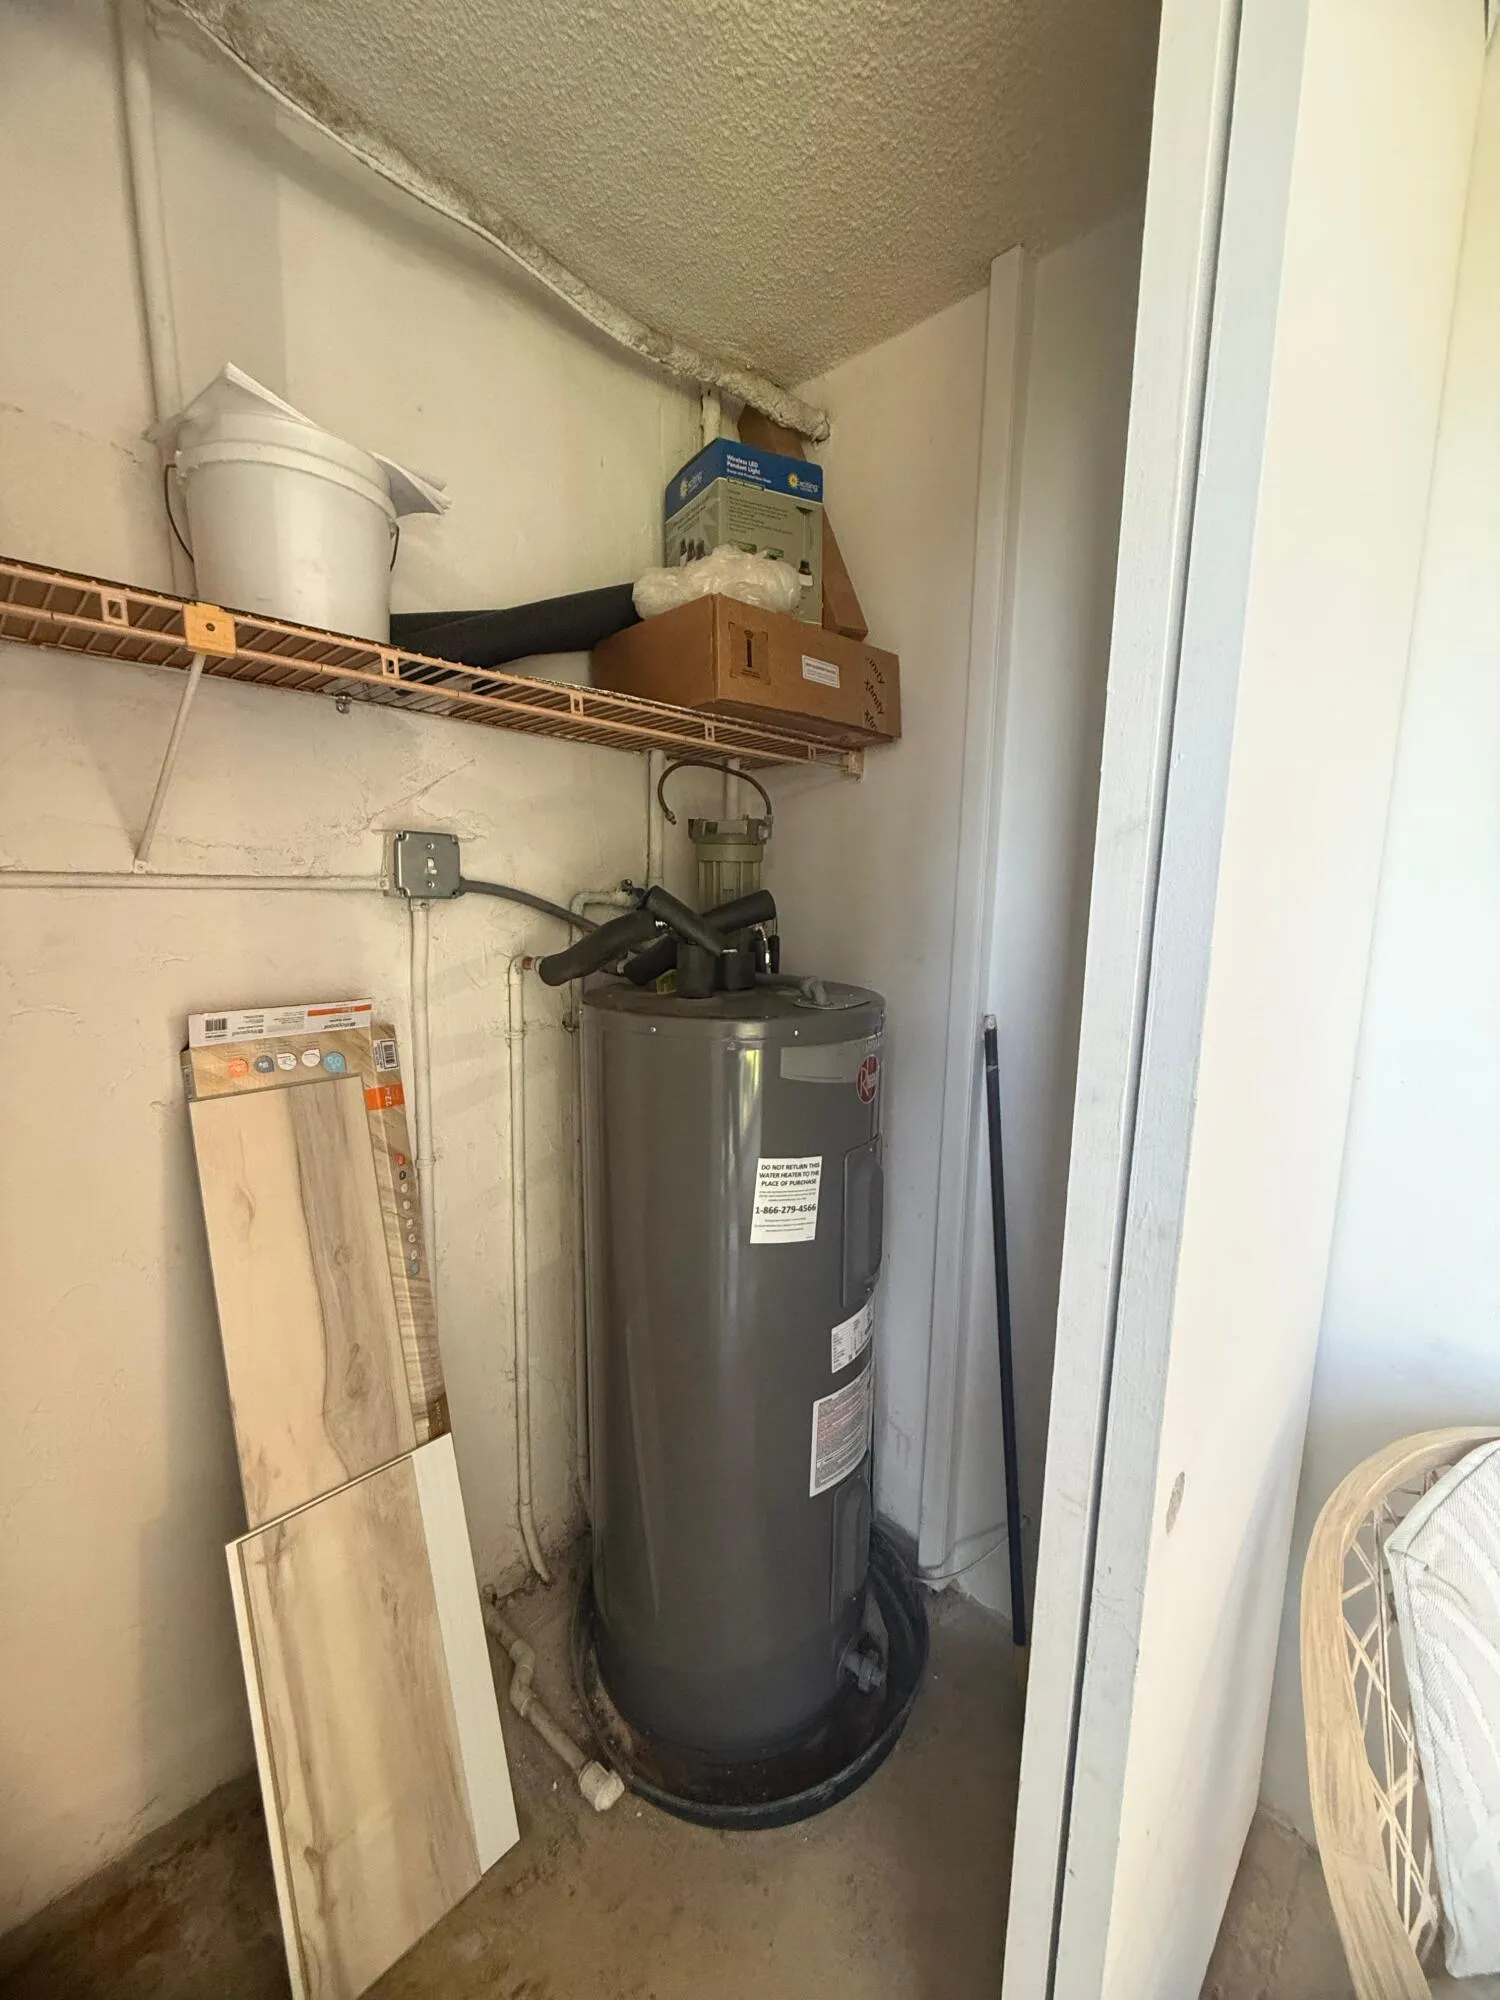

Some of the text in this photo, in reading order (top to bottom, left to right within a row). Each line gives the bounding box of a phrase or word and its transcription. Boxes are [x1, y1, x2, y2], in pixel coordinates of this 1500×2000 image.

[726, 454, 748, 465] Wireless
[726, 461, 761, 475] Pendant Light
[864, 679, 885, 714] xfinity
[384, 1095, 392, 1107] 22
[755, 1203, 817, 1215] 1-866-279-4566
